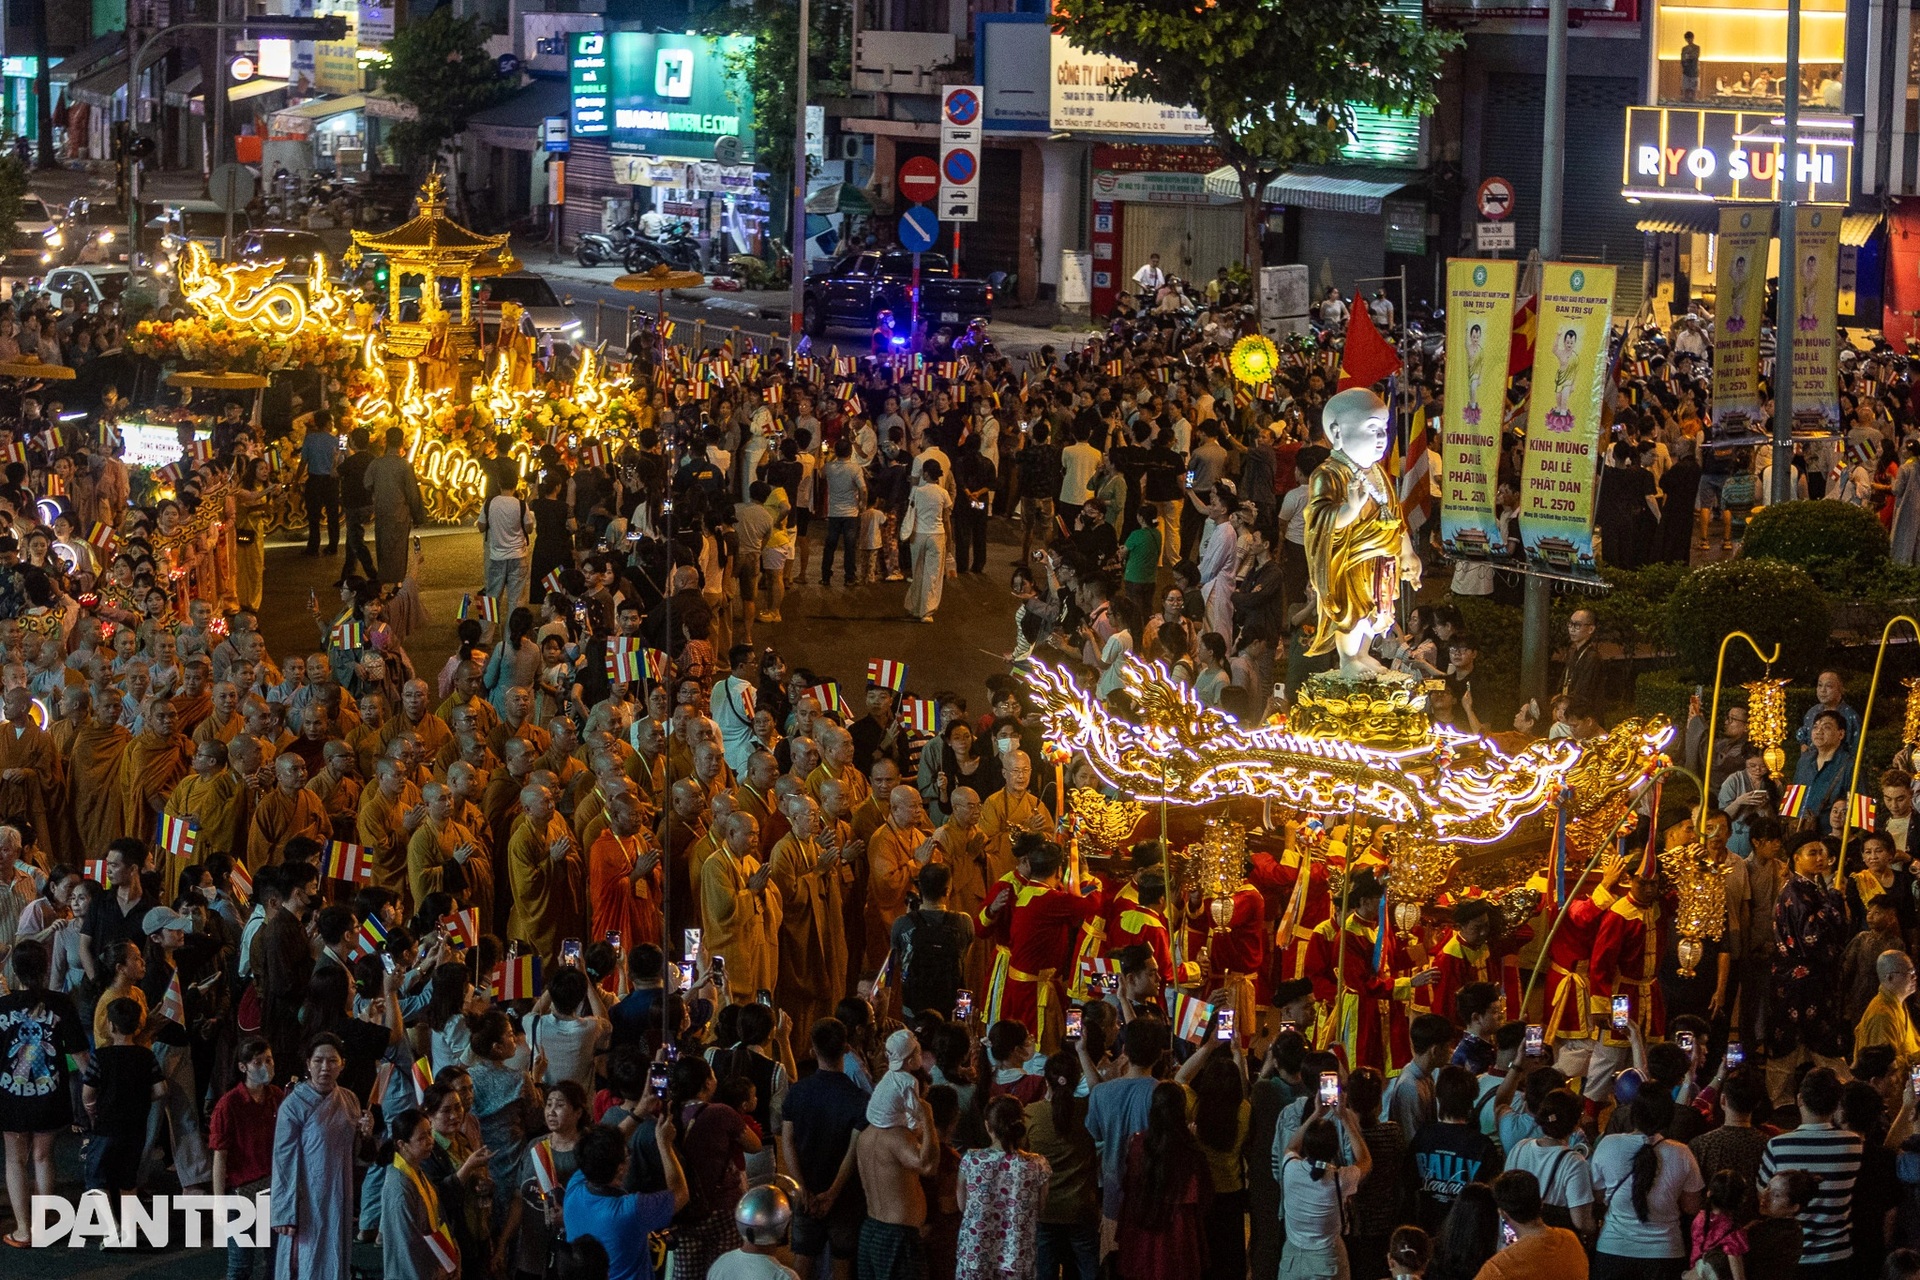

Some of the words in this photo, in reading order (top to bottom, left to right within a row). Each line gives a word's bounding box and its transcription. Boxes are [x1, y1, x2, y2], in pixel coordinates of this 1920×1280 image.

[1057, 60, 1080, 86] CÔNG
[1082, 64, 1094, 86] TY
[574, 84, 607, 94] MOBILE
[1638, 145, 1716, 178] RYO
[1556, 305, 1570, 313] BAN
[1571, 306, 1582, 315] TRỊ
[1583, 306, 1594, 316] SỰ
[1793, 365, 1807, 376] HẬT
[1730, 381, 1748, 390] 2570
[1804, 380, 1824, 389] 2570
[1446, 432, 1470, 444] KÍNH
[1471, 433, 1494, 447] MỪNG
[1530, 438, 1552, 453] KÍNH
[1556, 441, 1589, 456] MỪNG
[1460, 452, 1475, 466] ĐẠI
[1541, 460, 1558, 474] ĐẠI
[1561, 458, 1572, 474] LỄ
[1449, 470, 1475, 484] PHẬT
[1530, 478, 1555, 492] PHẬT
[1452, 490, 1468, 501] PL.
[1471, 490, 1486, 503] 2570
[1534, 496, 1548, 510] PL.
[1550, 498, 1576, 512] 2570
